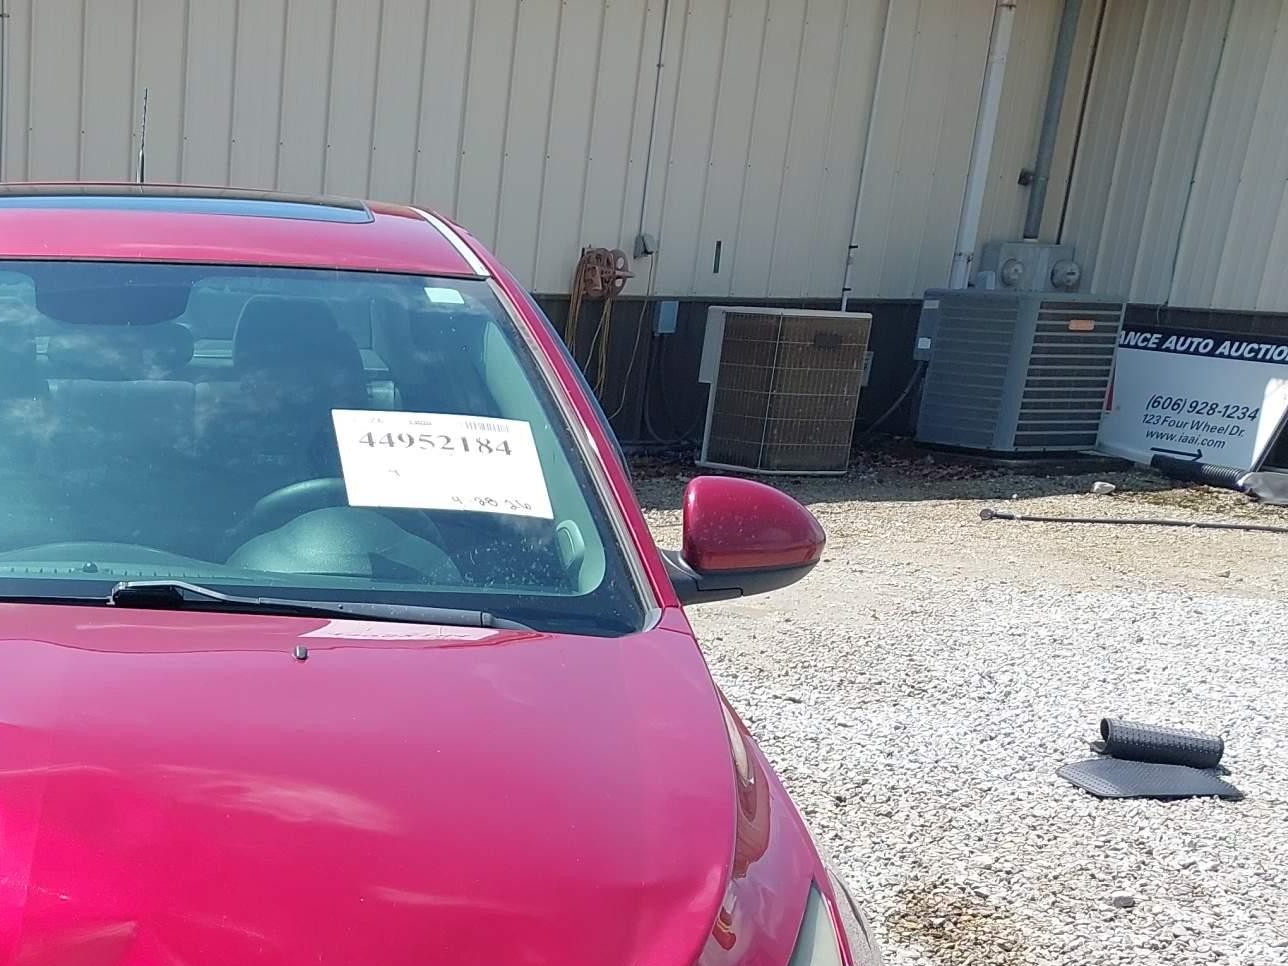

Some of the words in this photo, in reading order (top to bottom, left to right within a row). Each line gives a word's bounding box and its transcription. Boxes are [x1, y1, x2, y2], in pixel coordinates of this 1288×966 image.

[1162, 335, 1214, 354] AUTO
[1145, 394, 1187, 415] (606)
[1186, 400, 1260, 421] 928-1234
[1142, 413, 1162, 426] 123
[1160, 416, 1189, 429] Four
[1190, 420, 1230, 435] Wheel
[1228, 425, 1246, 437] Dr.
[359, 432, 512, 456] 44952184
[1145, 430, 1226, 449] www.iaai.com
